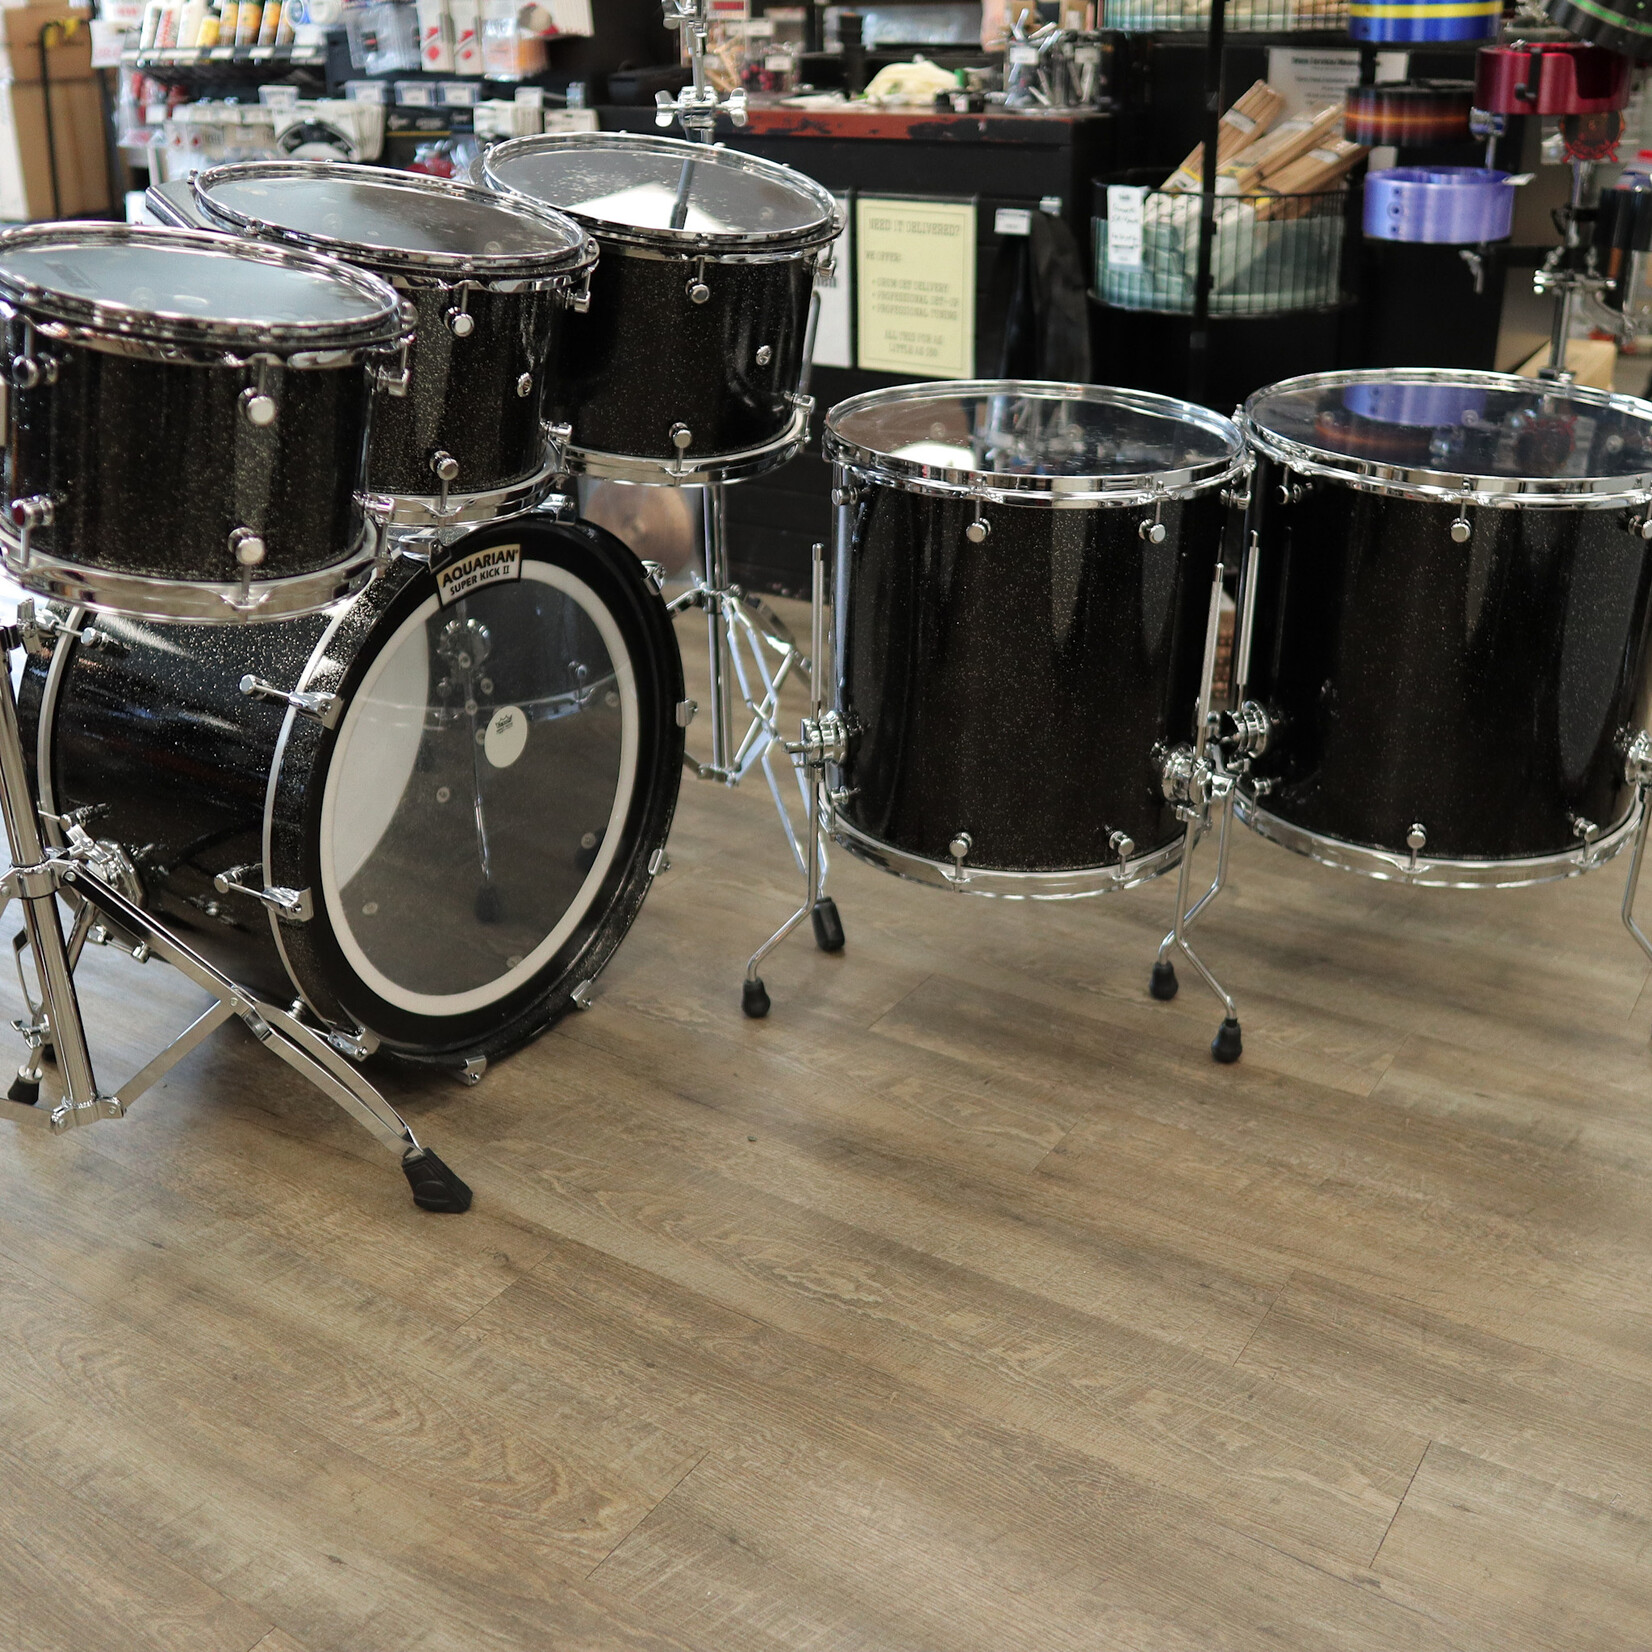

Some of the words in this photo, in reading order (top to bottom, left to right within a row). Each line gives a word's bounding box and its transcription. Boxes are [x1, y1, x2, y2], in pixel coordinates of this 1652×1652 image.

[870, 218, 891, 231] NEED
[894, 220, 904, 233] IT
[906, 221, 961, 237] DELIVERED?
[865, 250, 875, 260] WE
[914, 280, 950, 293] DELIVERY
[877, 291, 929, 305] PROFESSIONAL
[877, 304, 929, 318] PROFESSIONAL
[443, 549, 515, 587] AQUARIAN
[450, 575, 478, 595] SUPER
[479, 567, 500, 581] KICK
[502, 565, 510, 575] II
